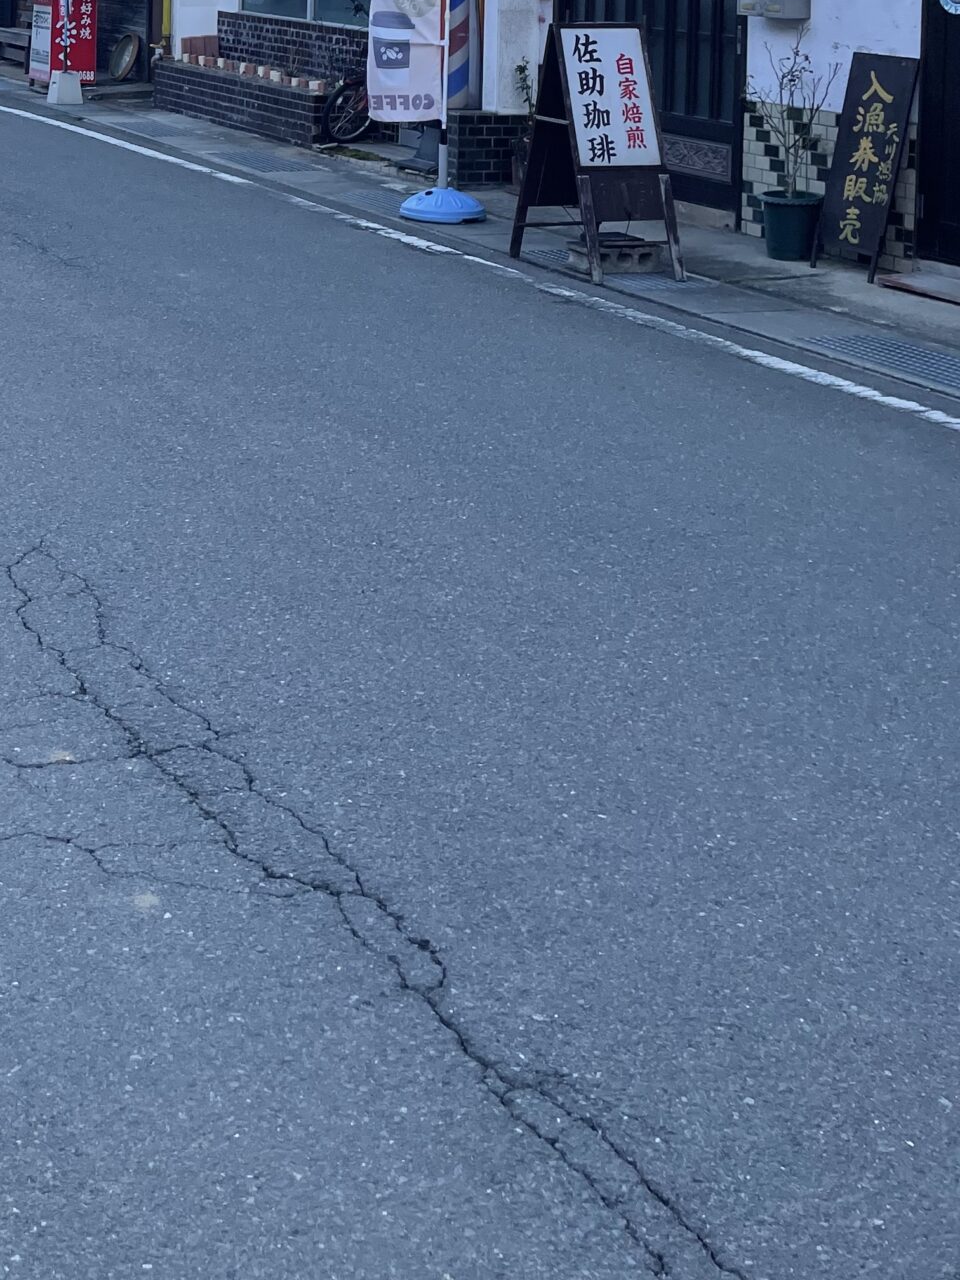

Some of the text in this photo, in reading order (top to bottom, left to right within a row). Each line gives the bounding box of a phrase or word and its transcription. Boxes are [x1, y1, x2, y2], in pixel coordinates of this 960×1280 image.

[571, 33, 618, 164] 佐助珈琲
[615, 52, 648, 150] 自家焙煎
